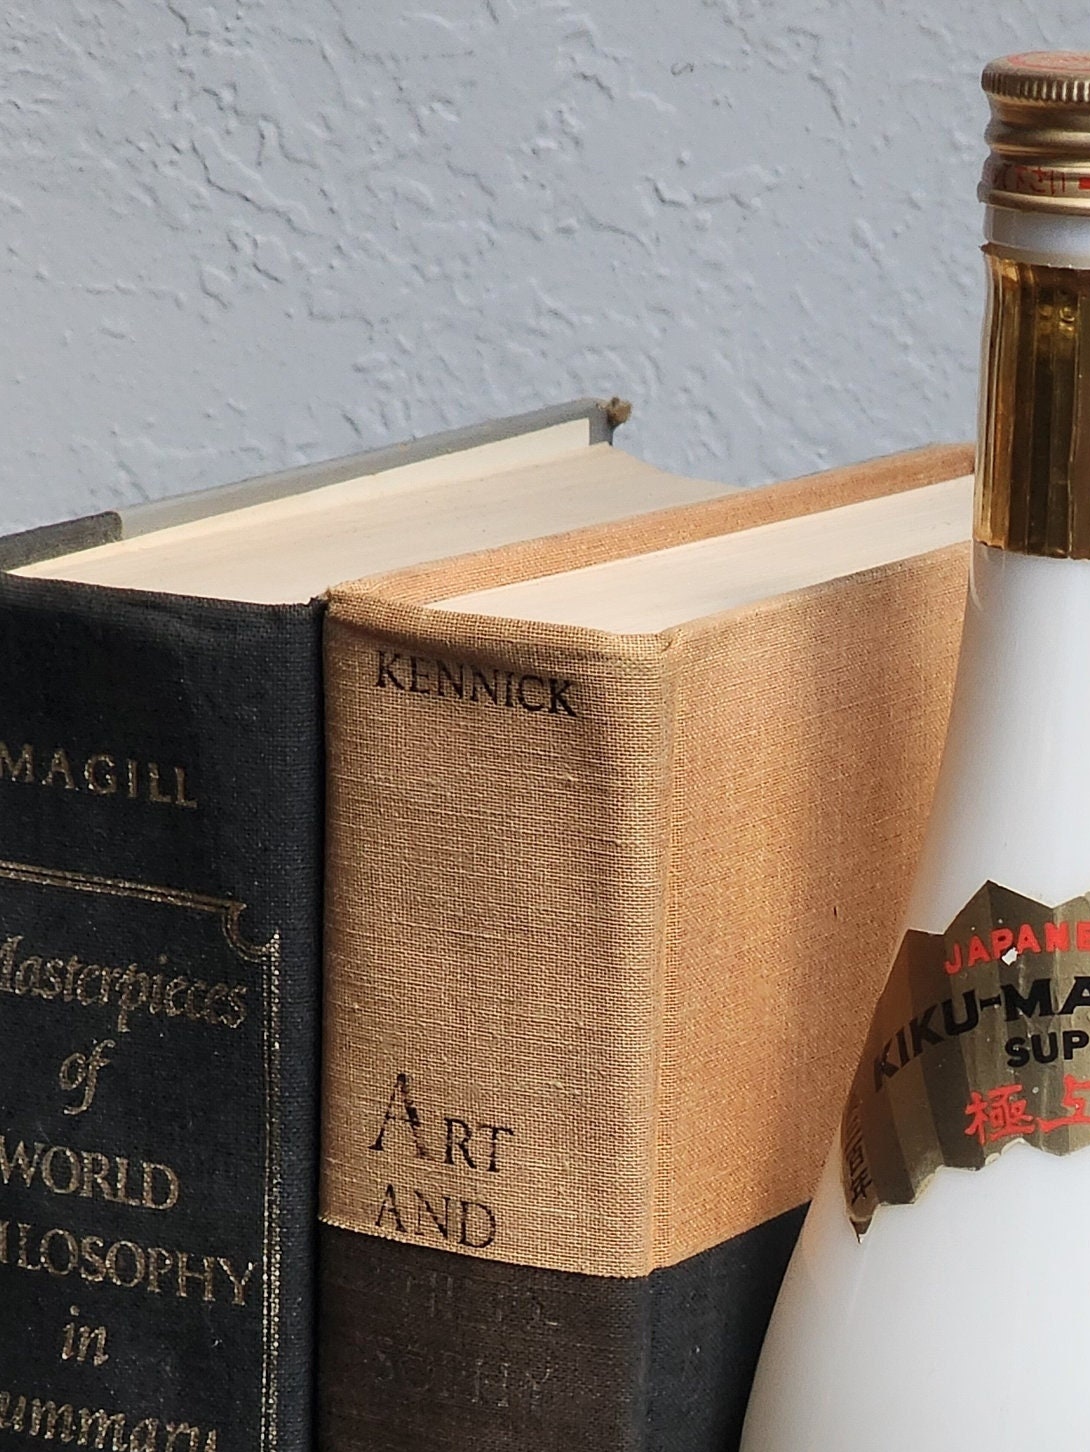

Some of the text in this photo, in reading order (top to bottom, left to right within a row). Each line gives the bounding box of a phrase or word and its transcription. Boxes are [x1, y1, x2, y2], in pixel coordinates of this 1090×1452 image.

[375, 649, 578, 718] KENNICK
[0, 740, 198, 809] MAGILL
[58, 1039, 117, 1115] of
[0, 1134, 181, 1211] WORLD
[374, 1183, 497, 1248] AND
[61, 1304, 110, 1367] in
